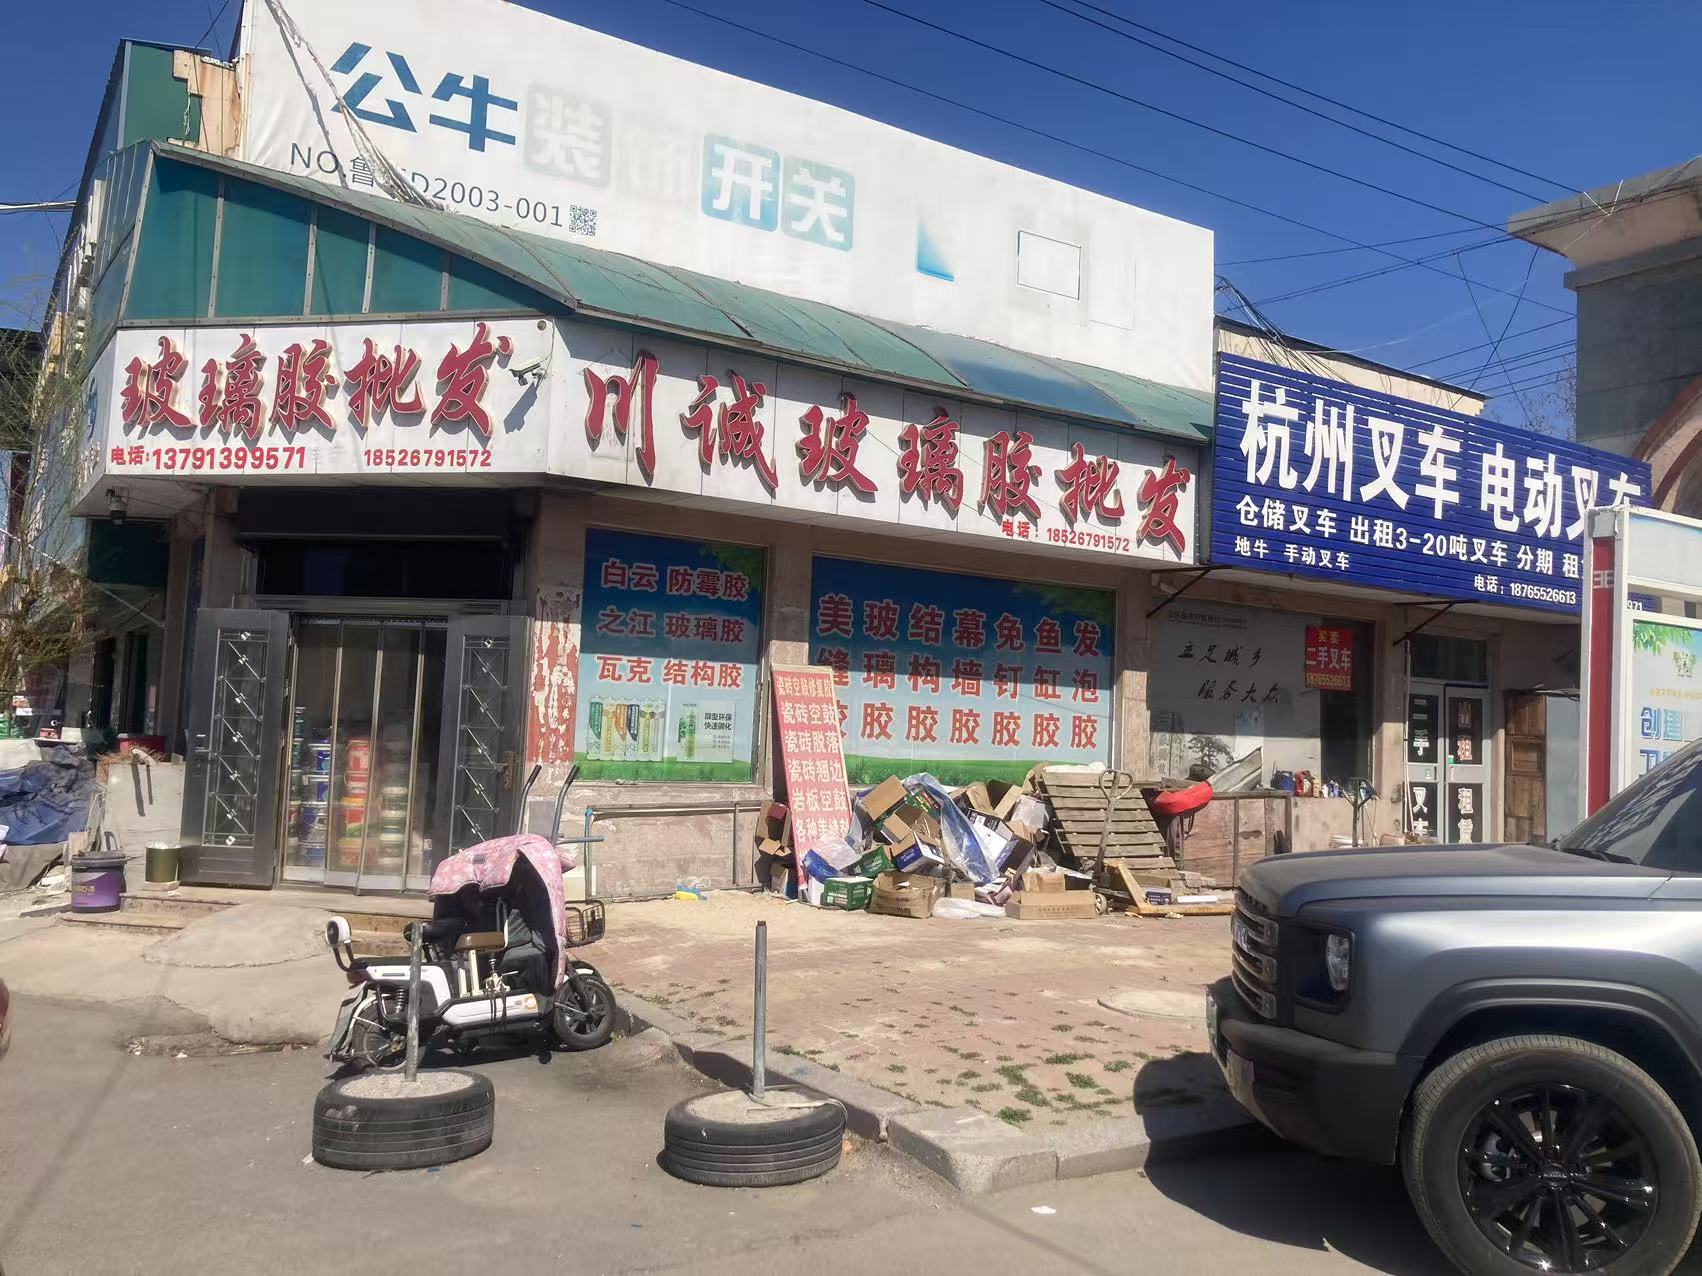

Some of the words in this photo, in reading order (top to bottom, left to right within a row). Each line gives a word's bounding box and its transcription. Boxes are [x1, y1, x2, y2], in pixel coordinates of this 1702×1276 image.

[330, 42, 517, 152] 公牛
[119, 321, 512, 440] 玻璃胶批发
[364, 447, 492, 468] 18526791572
[1240, 379, 1461, 520] 杭州叉车
[1236, 494, 1337, 538] 仓储叉车
[1516, 544, 1553, 575] 分期
[1234, 535, 1269, 559] 地牛
[1283, 543, 1350, 571] 手动叉车
[602, 559, 658, 591] 白云
[667, 566, 748, 600] 防霉胶
[597, 608, 655, 637] 之江
[665, 613, 746, 644] 玻璃胶
[596, 656, 653, 684] 瓦克
[662, 659, 743, 689] 结构胶
[1305, 645, 1352, 671] 二手叉车
[780, 701, 837, 725] 瓷砖空鼓
[784, 730, 840, 754] 瓷砖脱落
[788, 759, 844, 783] 瓷砖翘边
